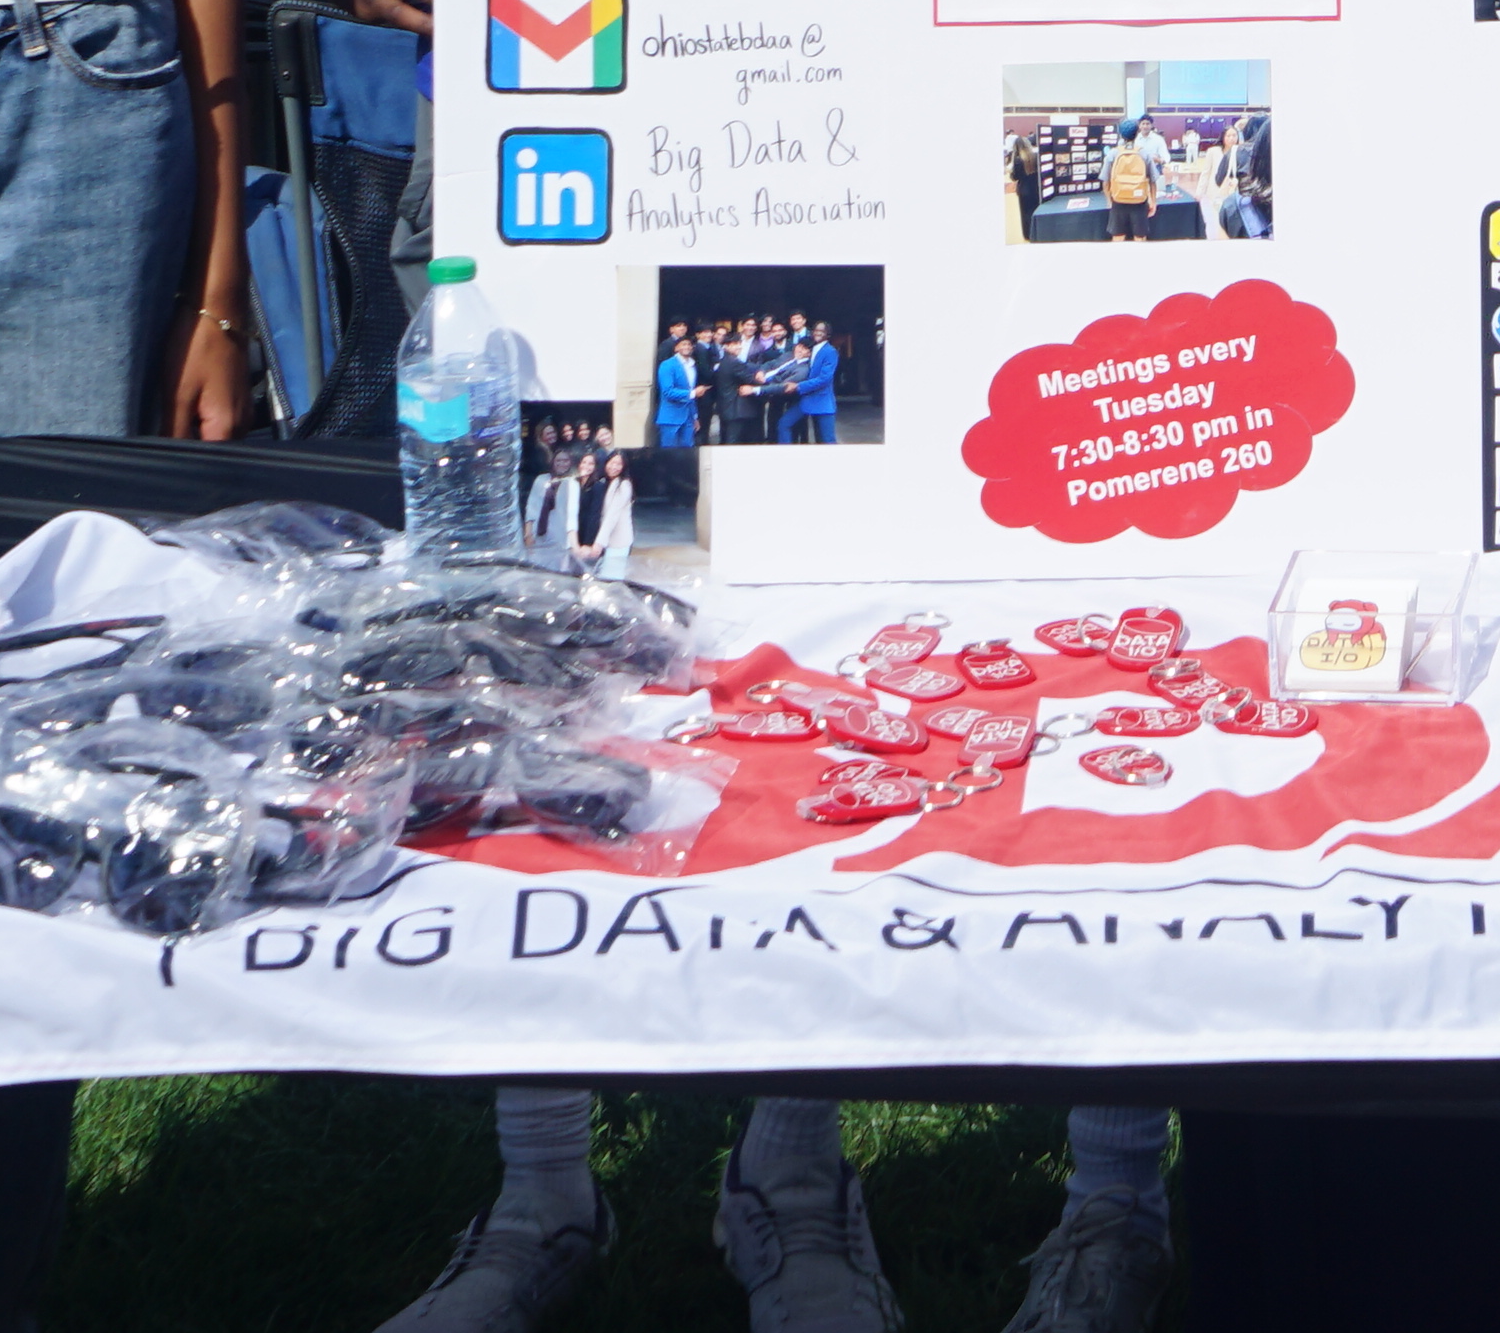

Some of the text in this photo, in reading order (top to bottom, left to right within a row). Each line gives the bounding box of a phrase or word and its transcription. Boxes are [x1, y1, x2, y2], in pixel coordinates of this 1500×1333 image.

[642, 14, 794, 58] ohiostatebdaa
[736, 60, 843, 106] gmail.com
[647, 107, 860, 193] Big Data &
[626, 187, 887, 249] Analytics Association
[1037, 334, 1257, 399] Meetings every
[1093, 380, 1216, 424] Tuesday
[1050, 404, 1274, 471] 7:30-8:30 pm in
[1066, 439, 1273, 506] Pomerene 260
[1115, 634, 1169, 647] DATA
[1320, 651, 1358, 665] I/O
